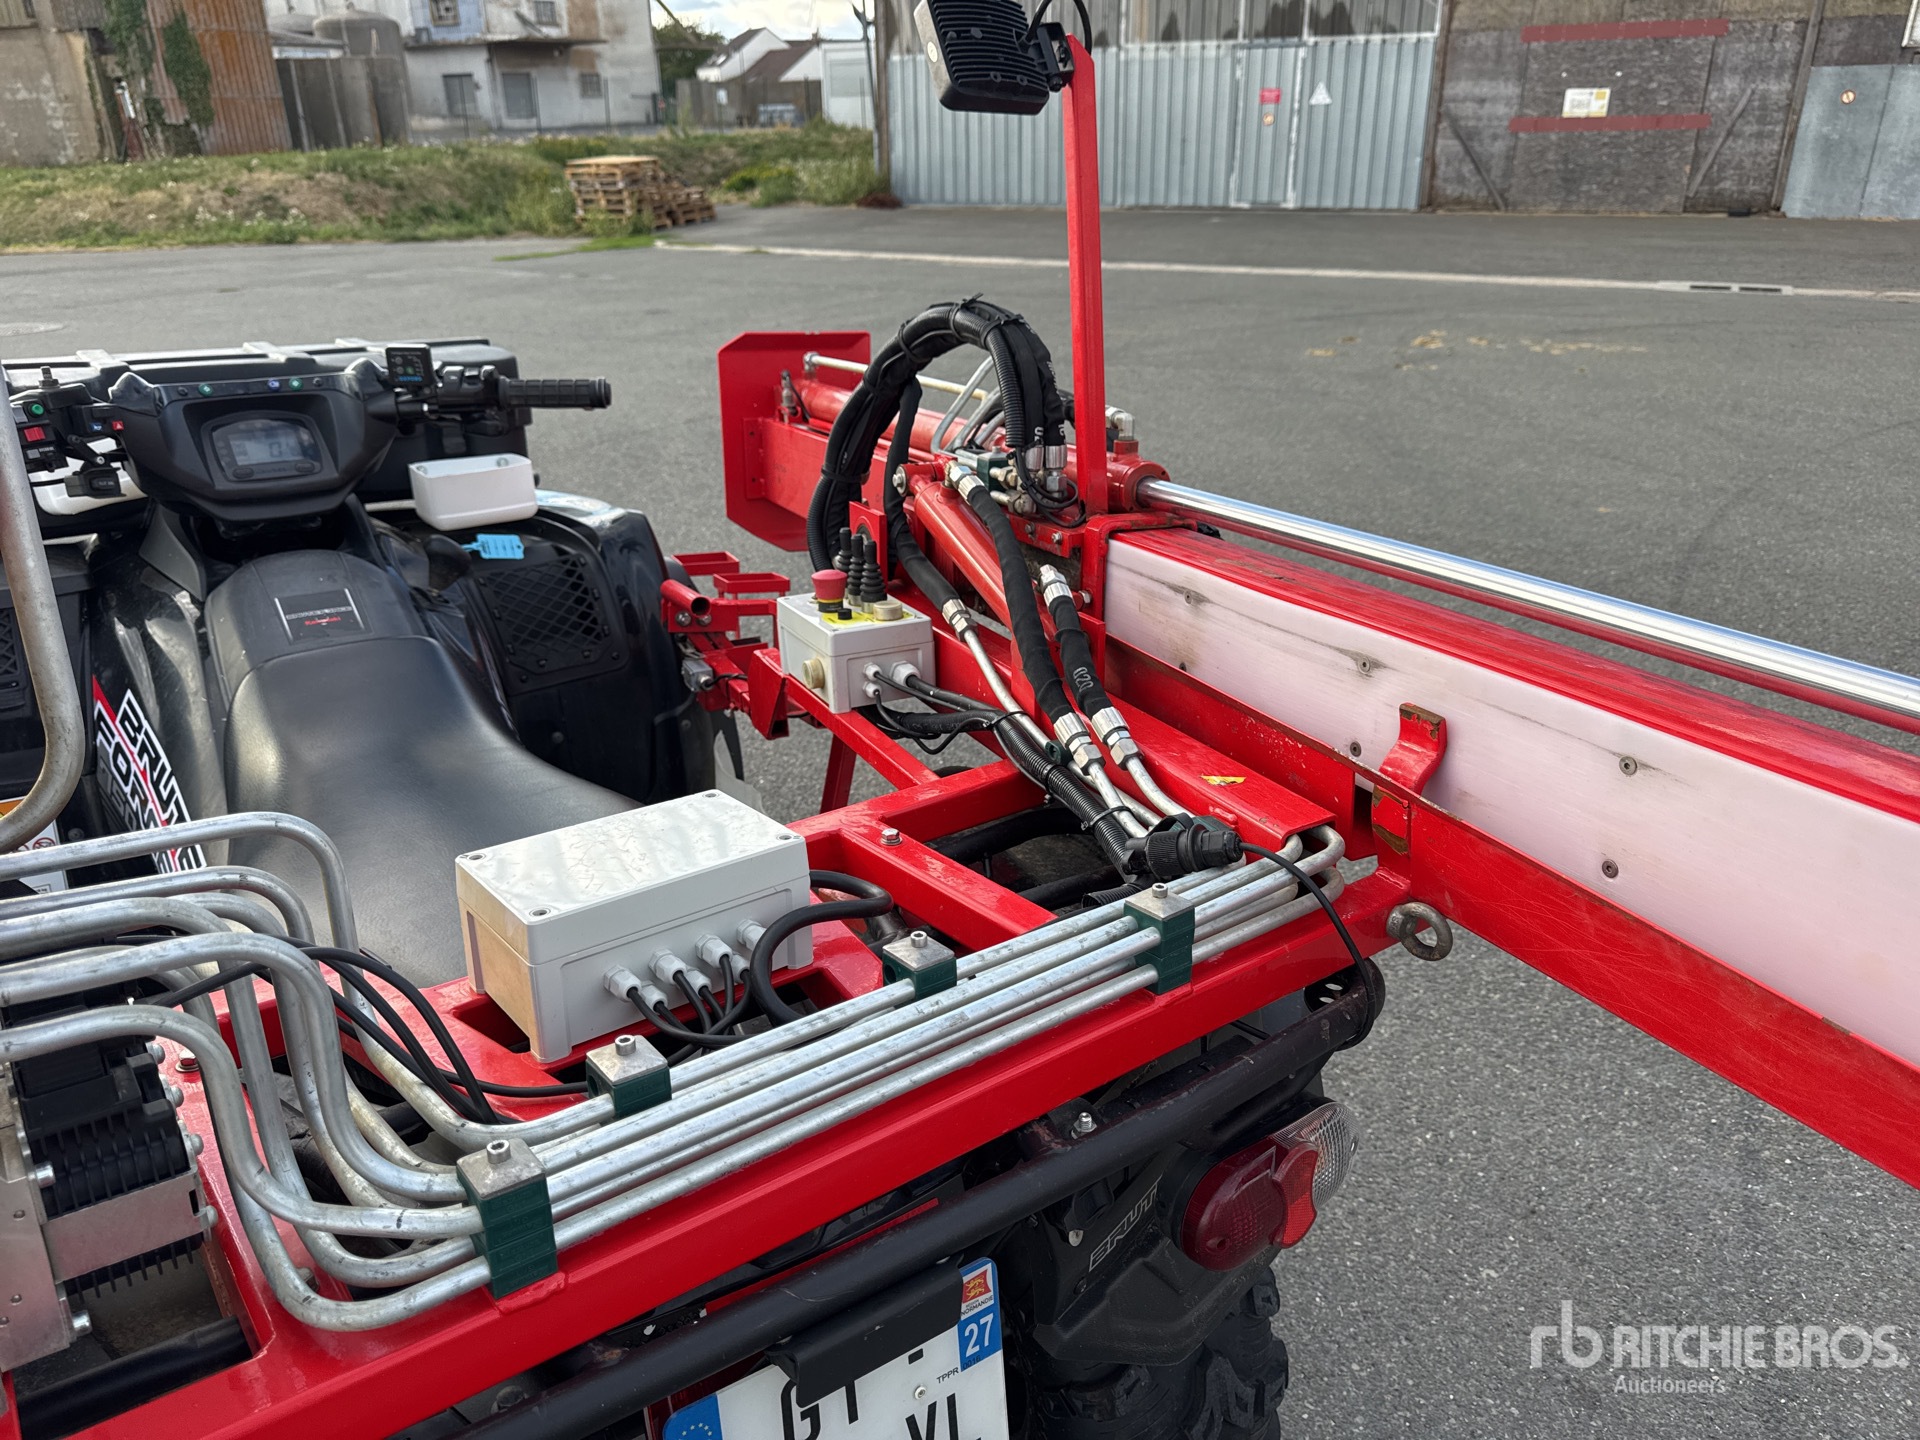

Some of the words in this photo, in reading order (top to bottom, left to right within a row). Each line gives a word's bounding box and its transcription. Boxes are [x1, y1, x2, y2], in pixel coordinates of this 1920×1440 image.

[964, 1312, 994, 1358] 27
[937, 1366, 959, 1384] TPPR
[962, 1355, 981, 1371] 0016
